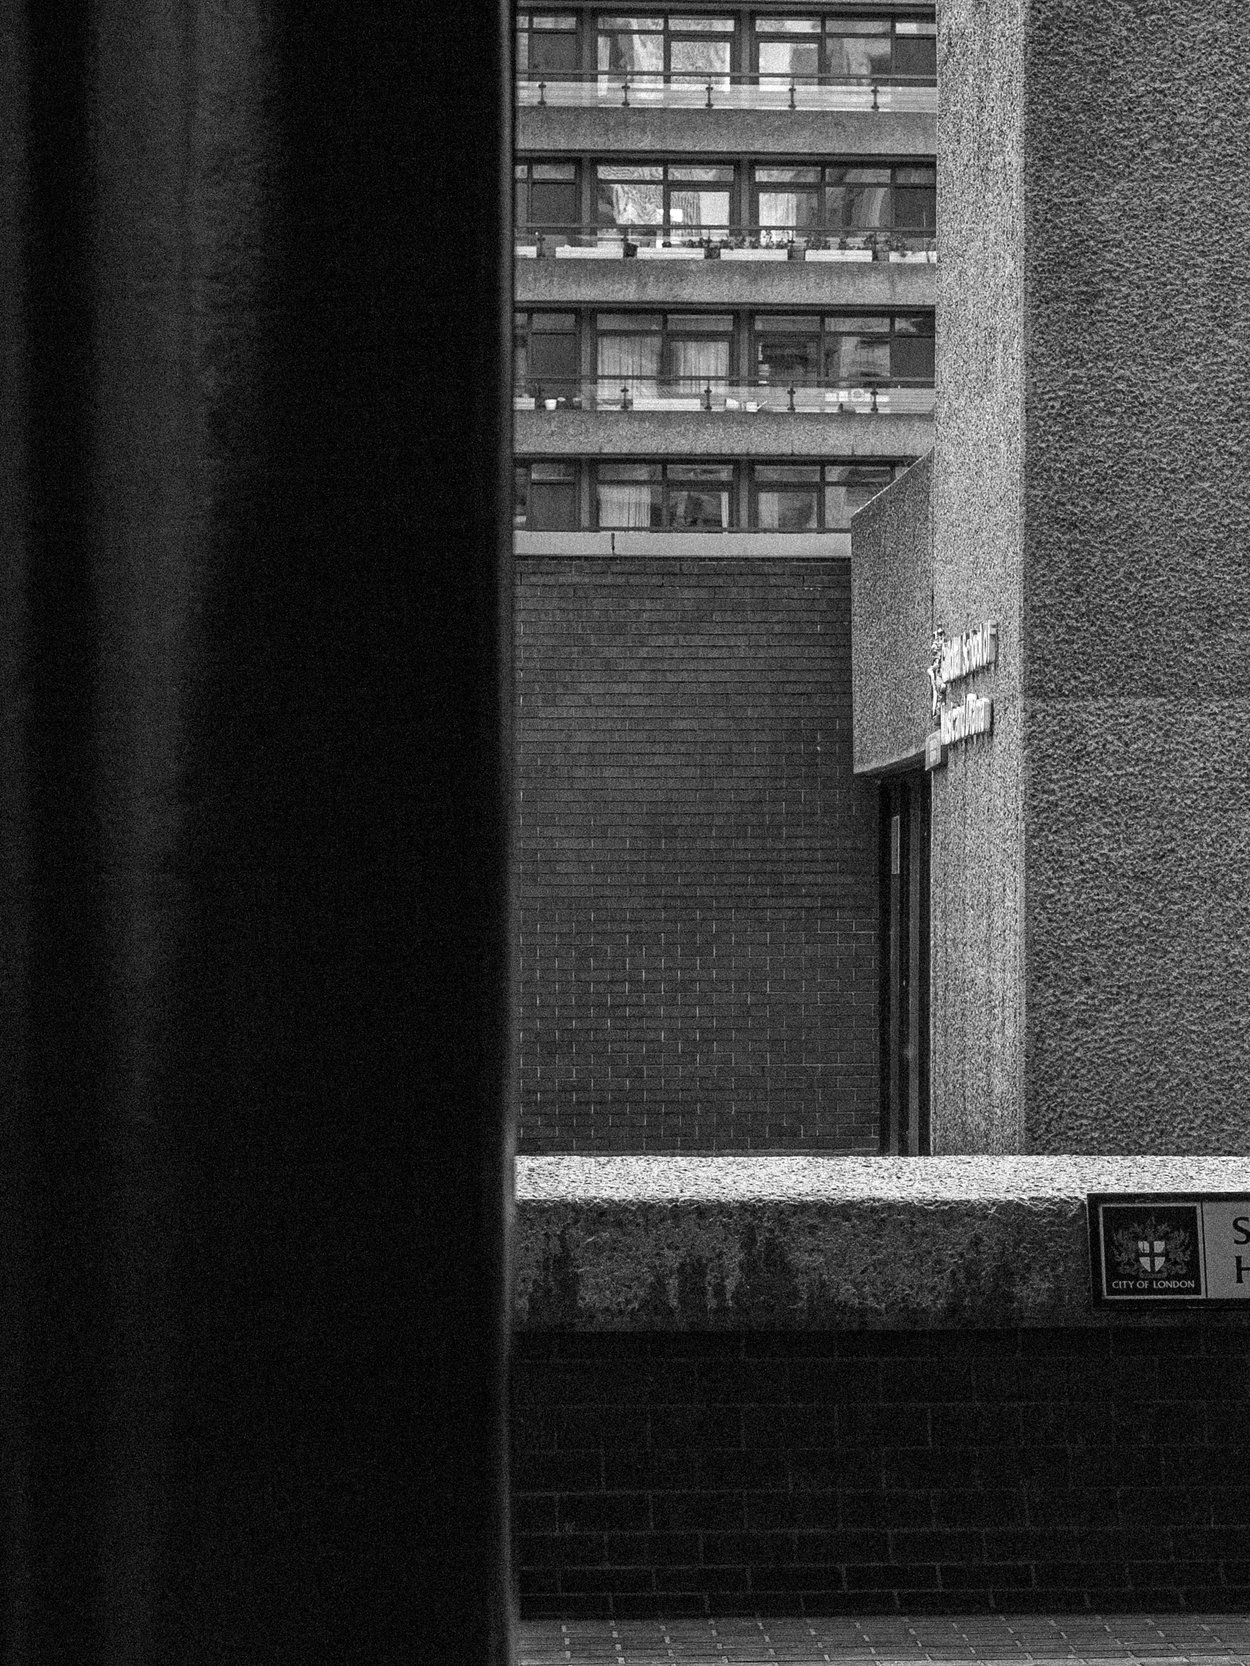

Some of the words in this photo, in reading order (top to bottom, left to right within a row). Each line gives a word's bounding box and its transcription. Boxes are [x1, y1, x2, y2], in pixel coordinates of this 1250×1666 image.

[1111, 1280, 1134, 1289] CITY
[1136, 1280, 1150, 1289] OF
[1153, 1280, 1195, 1289] LONDON
